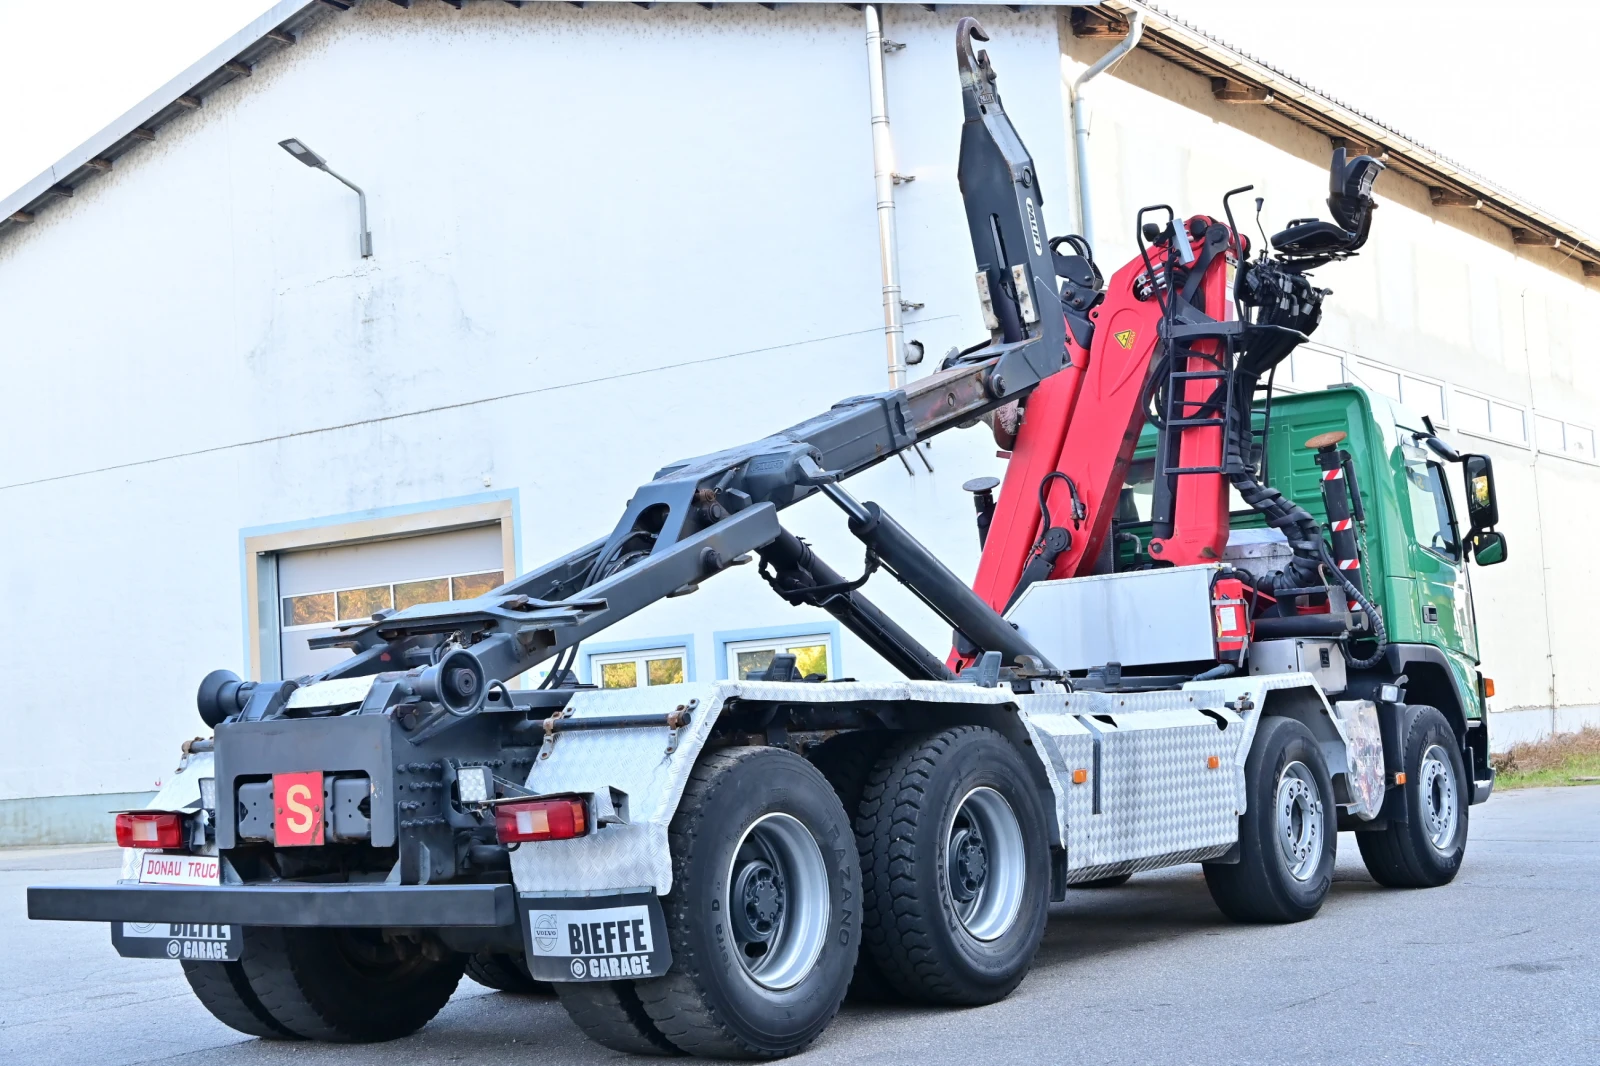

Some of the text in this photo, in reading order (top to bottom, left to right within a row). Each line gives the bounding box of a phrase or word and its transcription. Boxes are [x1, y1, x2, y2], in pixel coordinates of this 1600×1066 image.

[1026, 202, 1042, 251] PALIFT
[286, 784, 313, 834] S
[146, 859, 182, 876] DONAU
[821, 807, 853, 948] TRAZANO
[183, 940, 229, 960] GARAGE
[567, 918, 648, 955] BIEFFE
[588, 954, 652, 978] GARAGE
